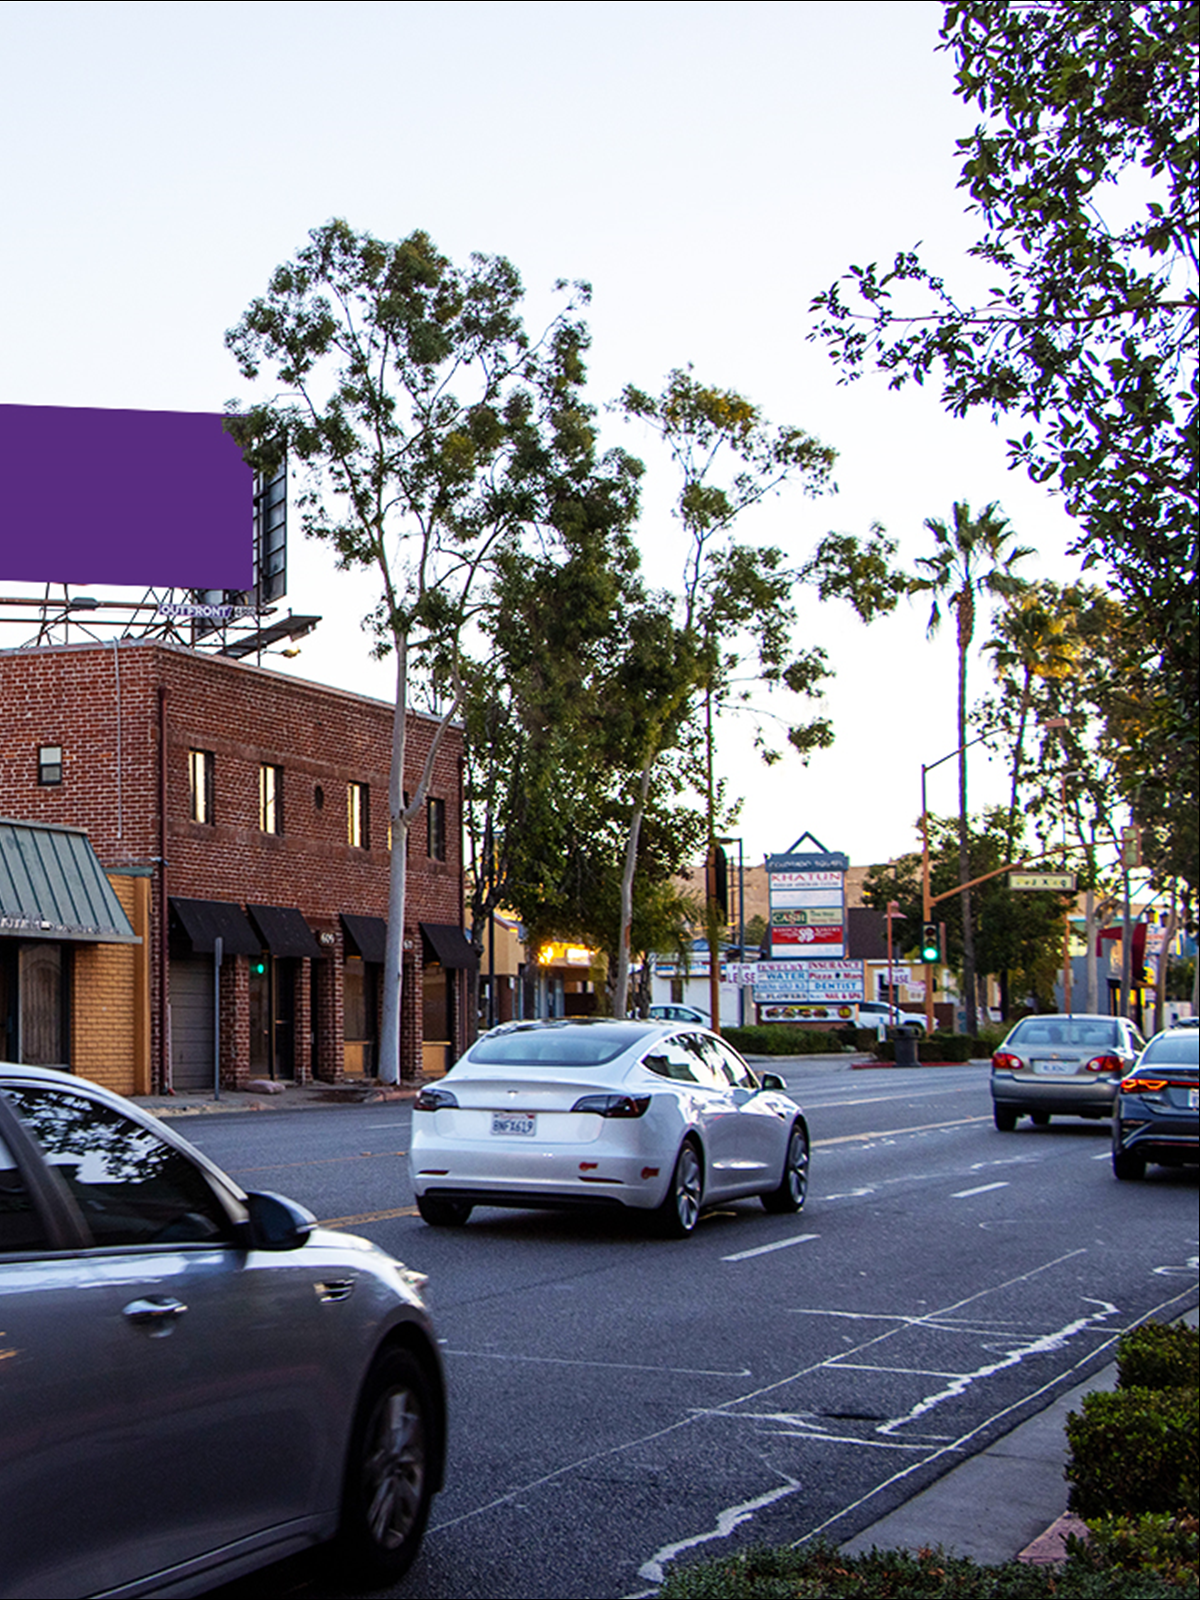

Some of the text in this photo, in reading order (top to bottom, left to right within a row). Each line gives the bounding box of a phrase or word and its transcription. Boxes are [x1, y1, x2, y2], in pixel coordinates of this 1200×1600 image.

[771, 873, 841, 882] KHATUN
[808, 961, 860, 970] INSURANCE
[766, 972, 805, 980] WATER
